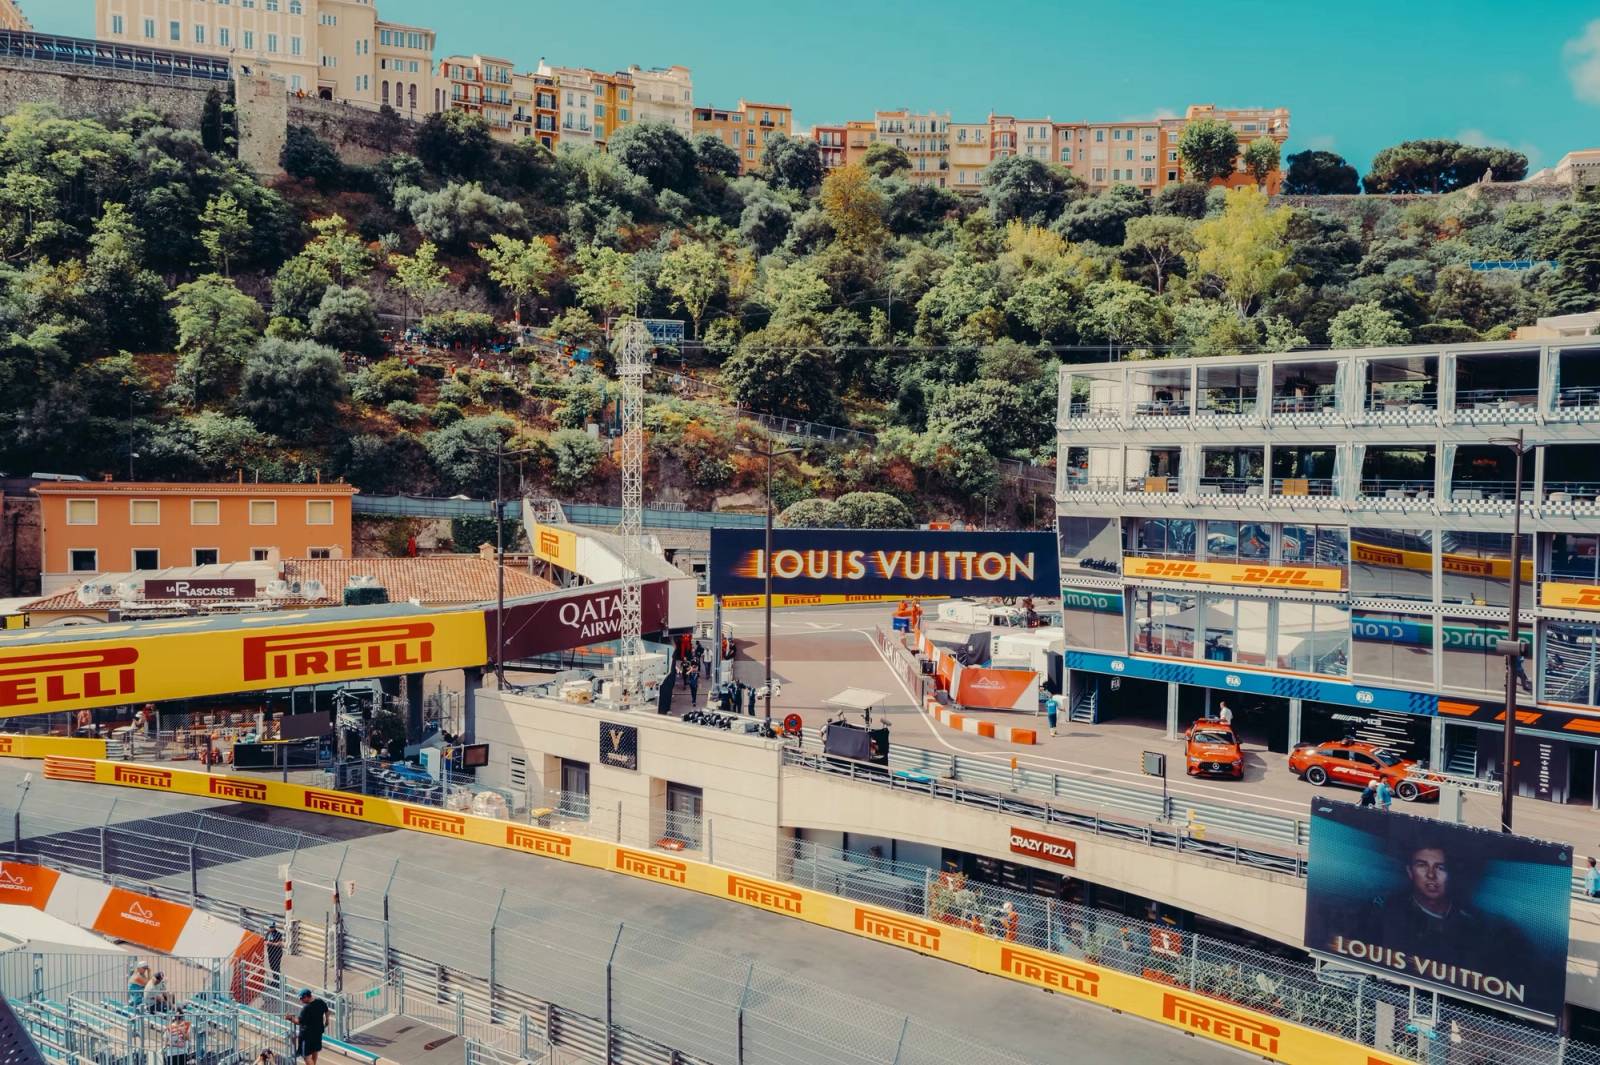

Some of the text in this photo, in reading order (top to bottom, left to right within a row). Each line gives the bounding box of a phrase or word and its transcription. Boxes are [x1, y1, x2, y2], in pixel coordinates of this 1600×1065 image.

[757, 549, 1034, 581] LOUIS VUITTON
[1145, 562, 1203, 578] DHL
[1244, 568, 1310, 585] DHL
[176, 582, 235, 597] RASCASSE
[243, 622, 435, 682] PIRELLI
[115, 766, 172, 788] PIRELLI
[209, 778, 267, 801] PIRELLI
[304, 791, 364, 816] PIRELLI
[403, 808, 464, 835] PIRELLI
[507, 827, 570, 856] PIRELLI
[1010, 835, 1074, 860] CRAZY PIZZA
[617, 849, 685, 882] PIRELLI
[728, 877, 801, 913] PIRELLI
[855, 909, 941, 951] PIRELLI
[1002, 947, 1100, 998] PIRELLI
[1337, 936, 1525, 1003] LOUIS VUITTON
[1163, 993, 1280, 1054] PIRELLI
